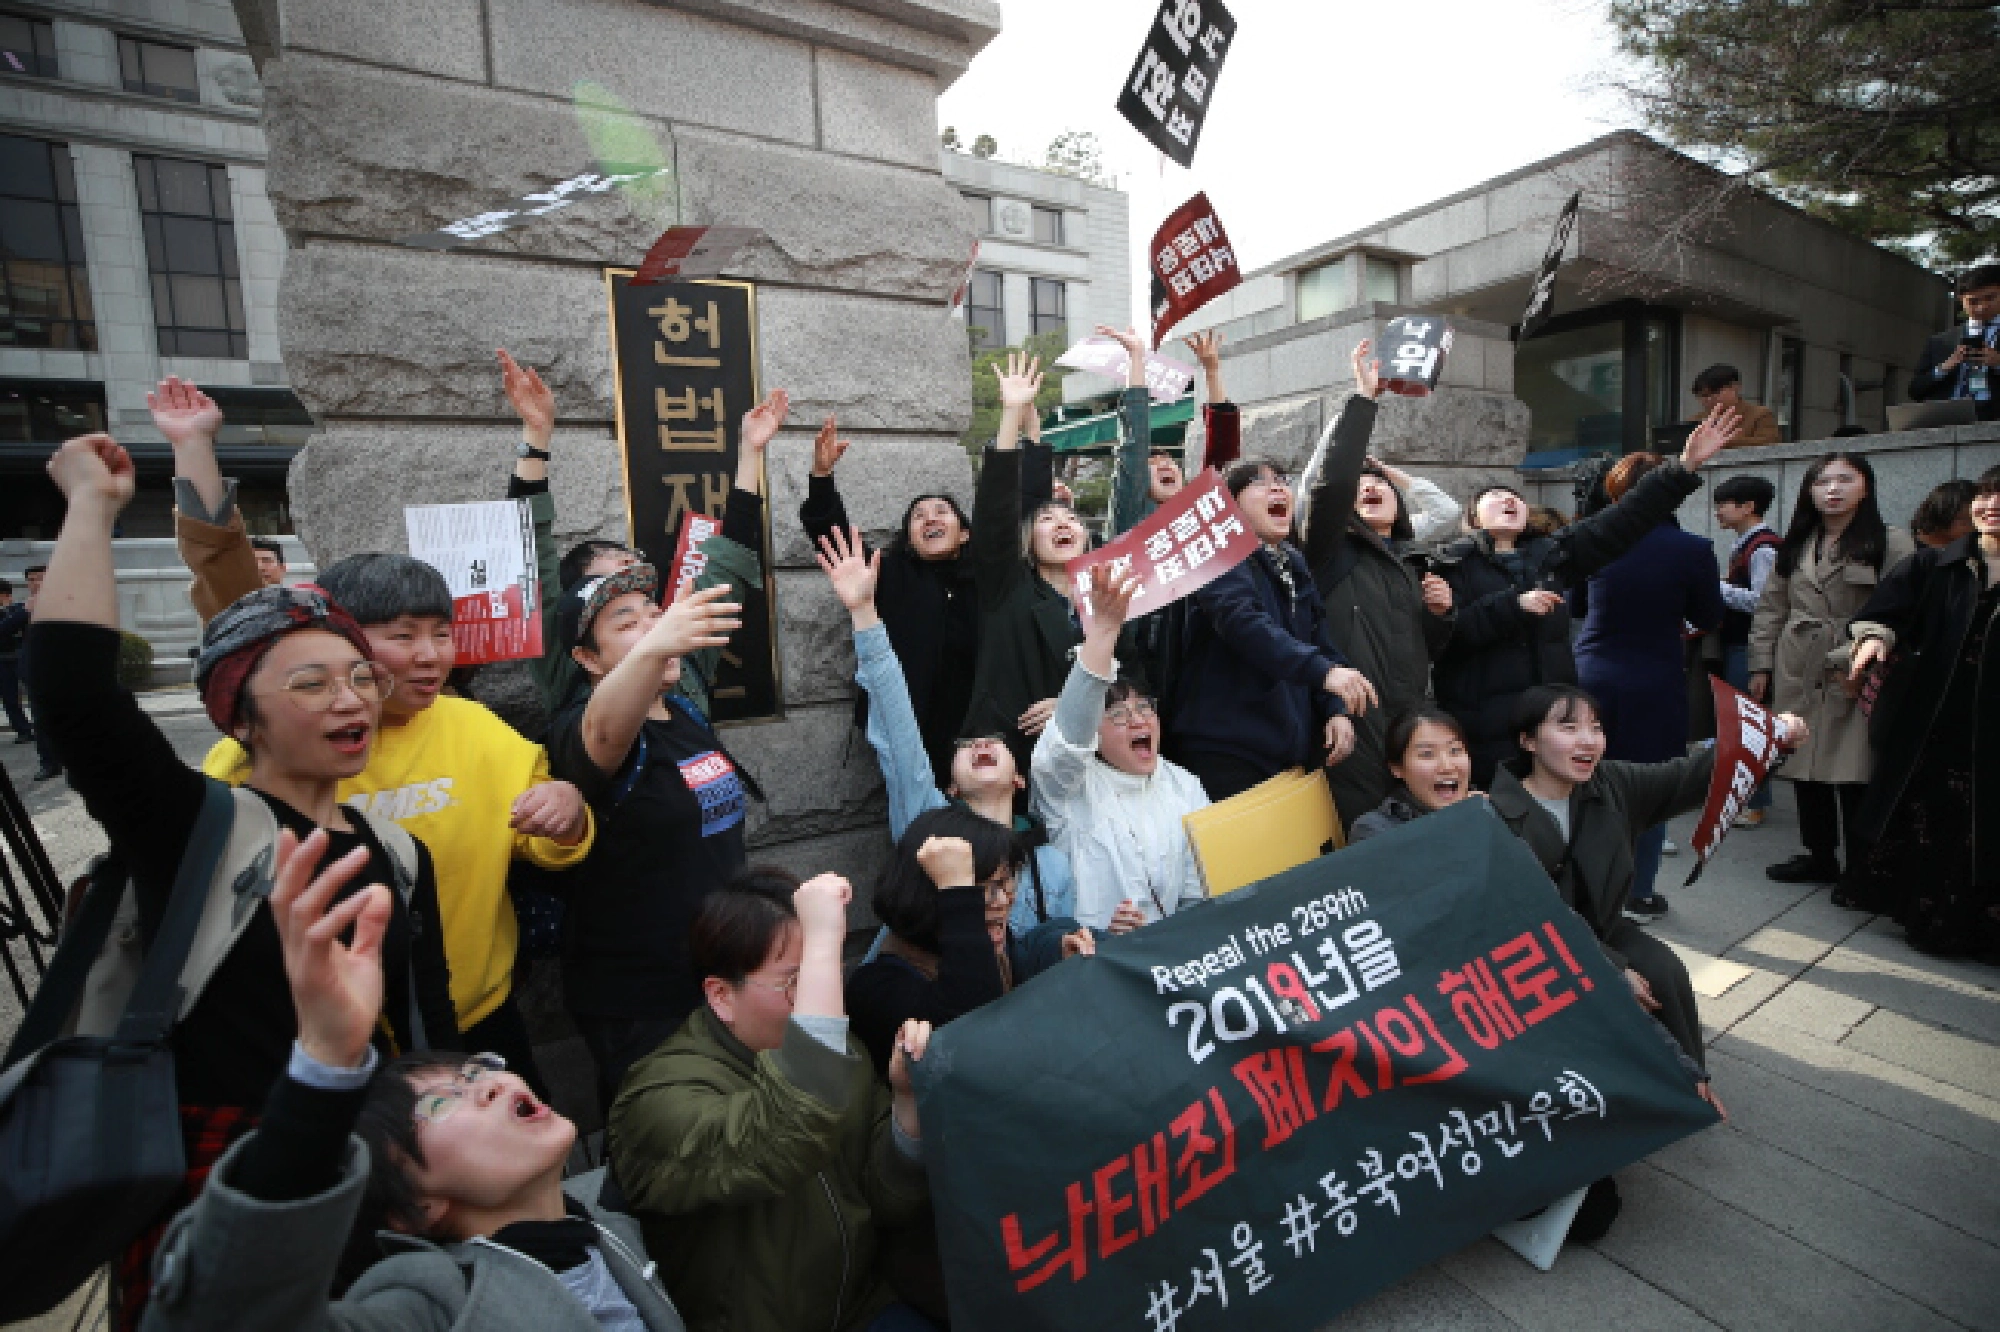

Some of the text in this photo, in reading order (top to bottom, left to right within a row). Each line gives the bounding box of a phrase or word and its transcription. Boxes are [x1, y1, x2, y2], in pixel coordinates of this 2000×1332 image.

[1157, 214, 1219, 274] 새로운
[1169, 246, 1233, 296] 낙태죄
[1145, 486, 1226, 560] 새로운
[1154, 514, 1243, 584] 낙태죄
[1150, 886, 1369, 994] Repeal the 269th
[1166, 920, 1403, 1064] 2019년을
[1000, 1086, 1238, 1292] 낙태죄
[1436, 920, 1595, 1050] 해로!
[1145, 1068, 1607, 1332] #서울 #동북여성민우회
